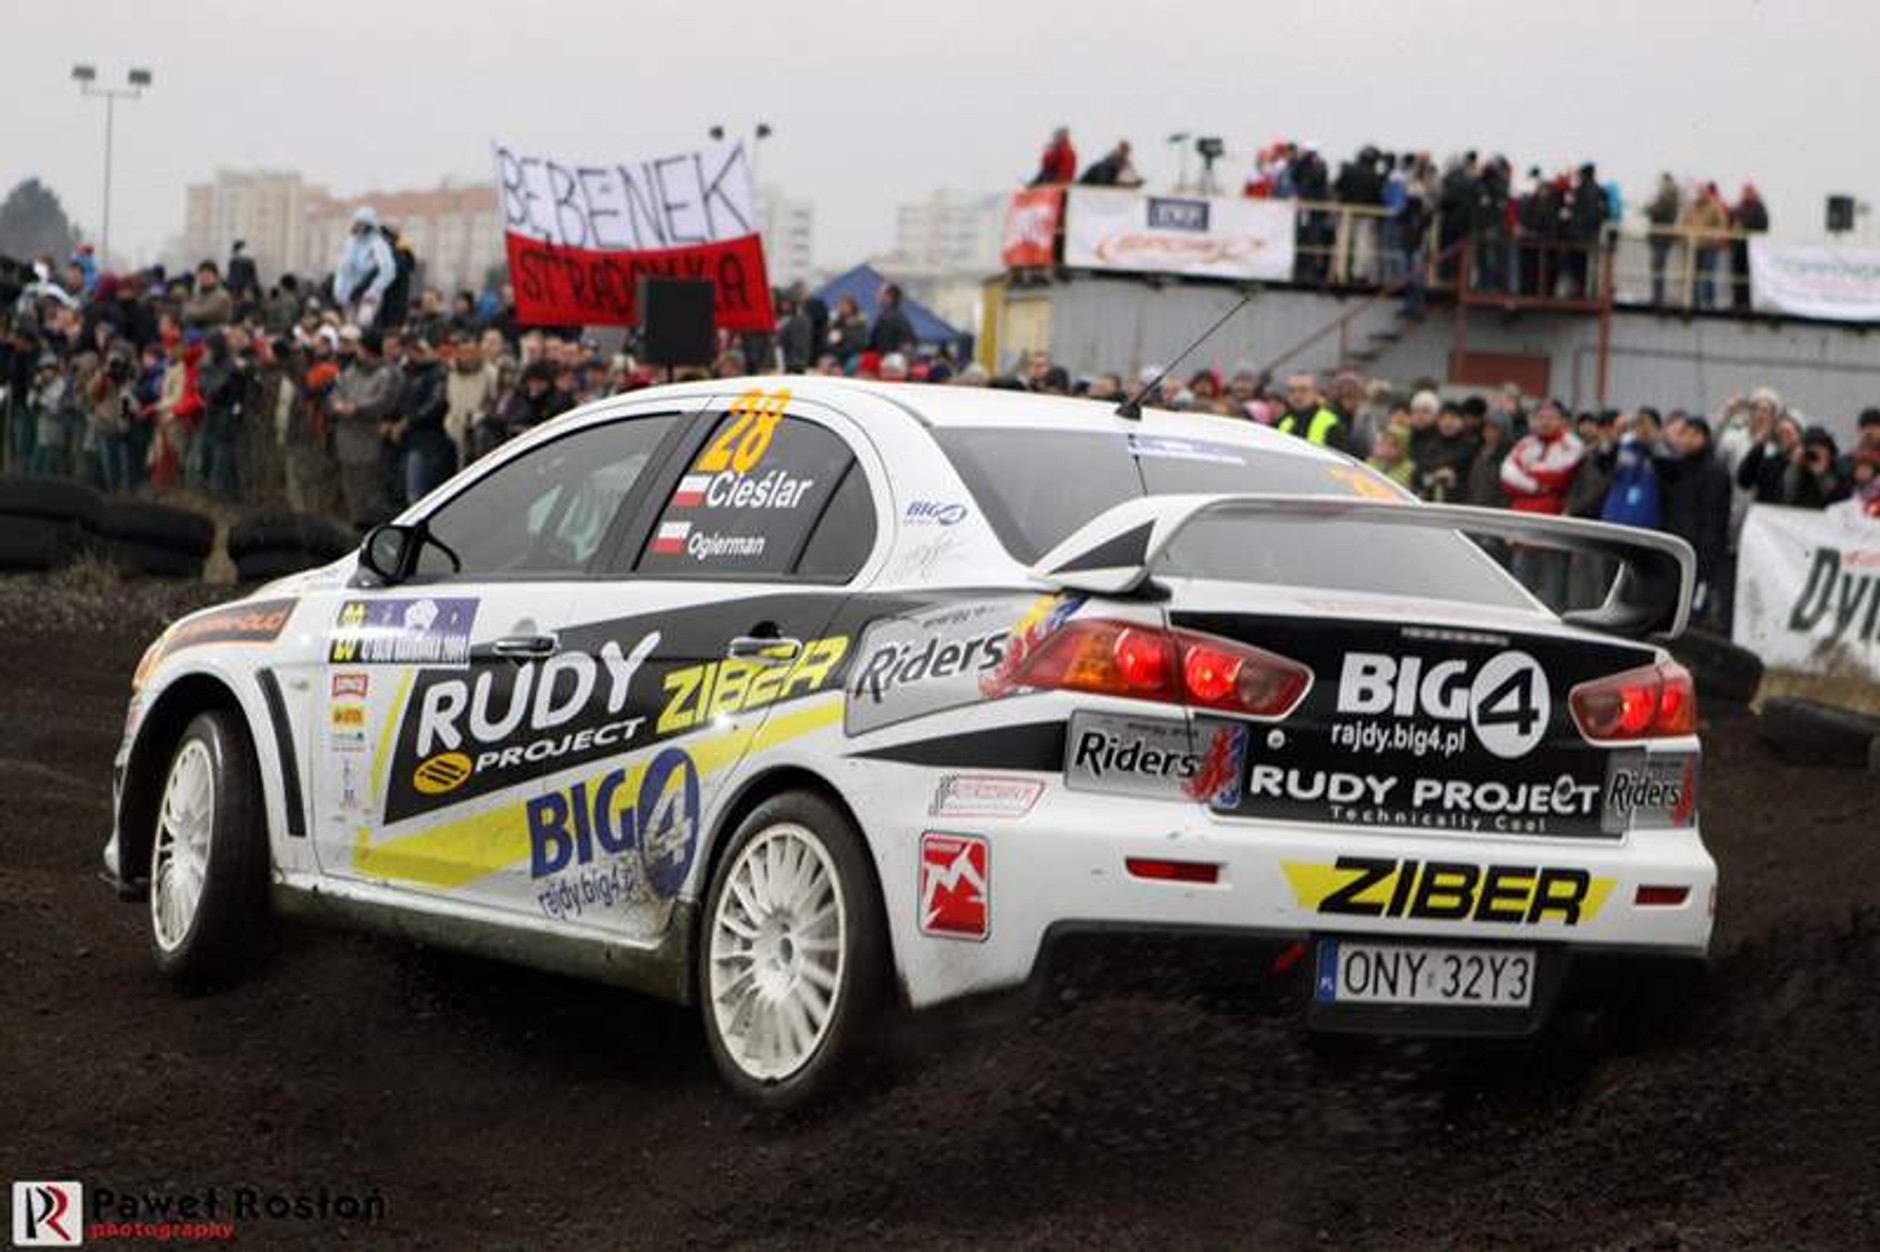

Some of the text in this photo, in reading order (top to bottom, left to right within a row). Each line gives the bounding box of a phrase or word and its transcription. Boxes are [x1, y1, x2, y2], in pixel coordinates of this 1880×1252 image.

[699, 388, 792, 474] 28
[707, 469, 813, 508] Cieślar
[688, 532, 765, 560] Ogierman
[854, 630, 1010, 703] Riders
[416, 631, 661, 757] RUDY
[475, 717, 647, 773] PROJECT
[1076, 731, 1197, 778] Riders
[1332, 721, 1465, 757] rajdy.big4.pl
[1250, 764, 1600, 815] RUDY PROJECT
[1609, 770, 1681, 813] Riders
[1317, 856, 1591, 926] ZIBER
[1344, 951, 1530, 1001] ONY 32Y3
